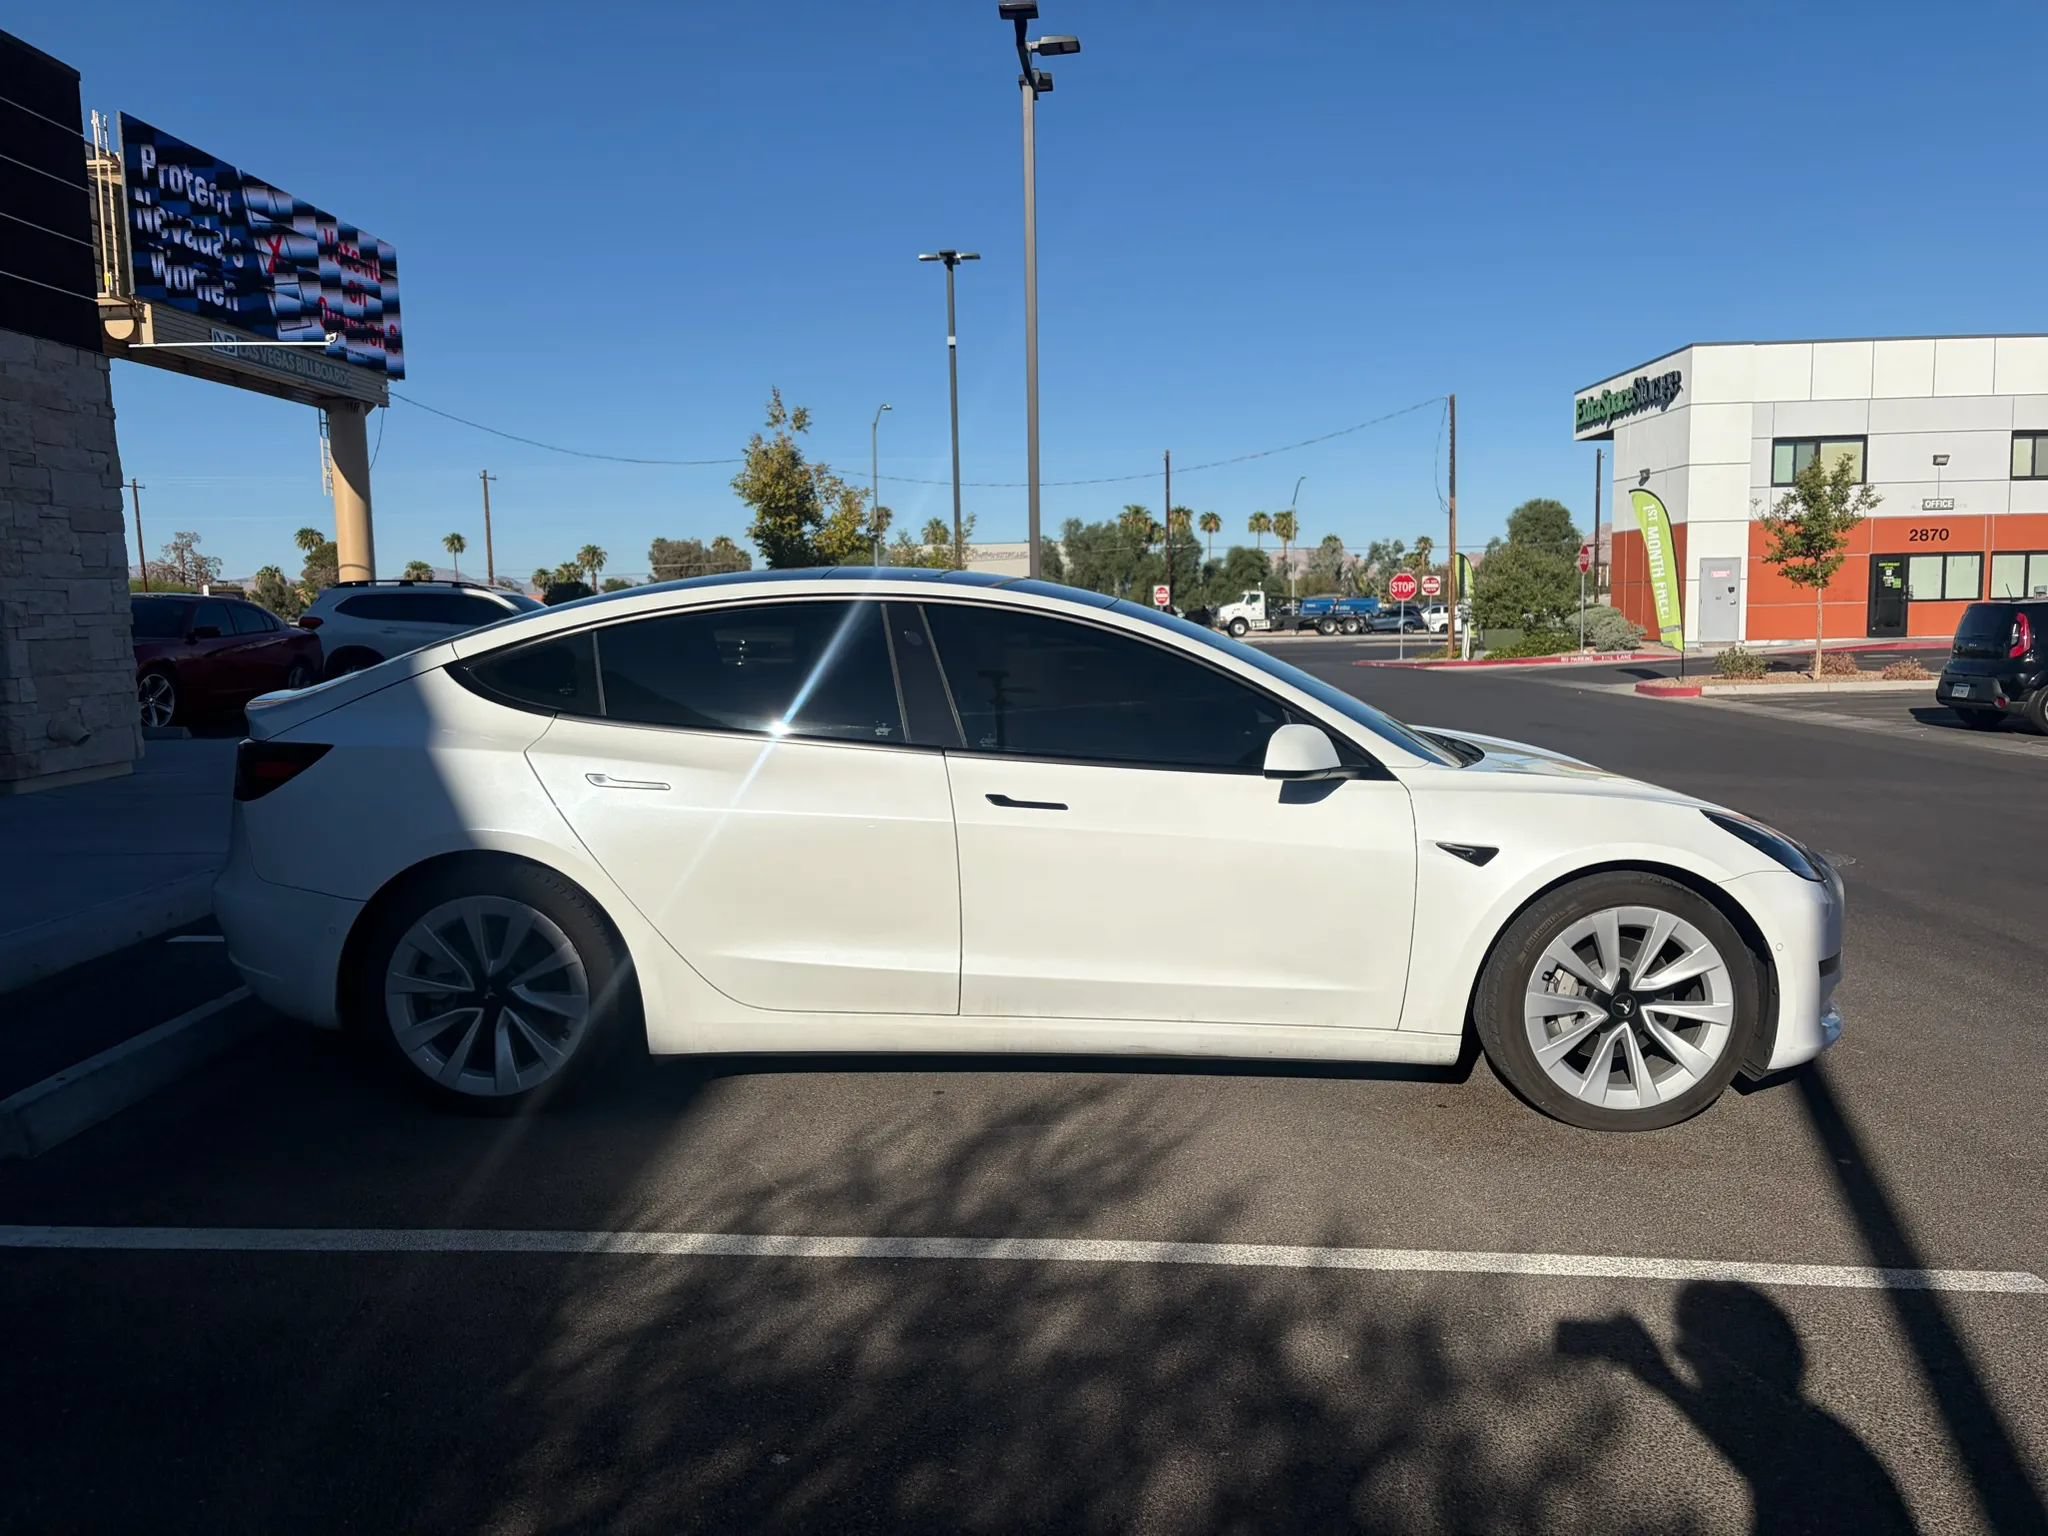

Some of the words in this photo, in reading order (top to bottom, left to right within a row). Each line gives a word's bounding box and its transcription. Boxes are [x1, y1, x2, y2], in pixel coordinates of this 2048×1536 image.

[140, 144, 233, 219] Protect
[258, 344, 294, 370] VEGAS
[1924, 499, 1953, 508] OFFICE
[1909, 528, 1950, 542] 2870
[1647, 526, 1665, 579] MONTH
[1391, 581, 1415, 593] STOP
